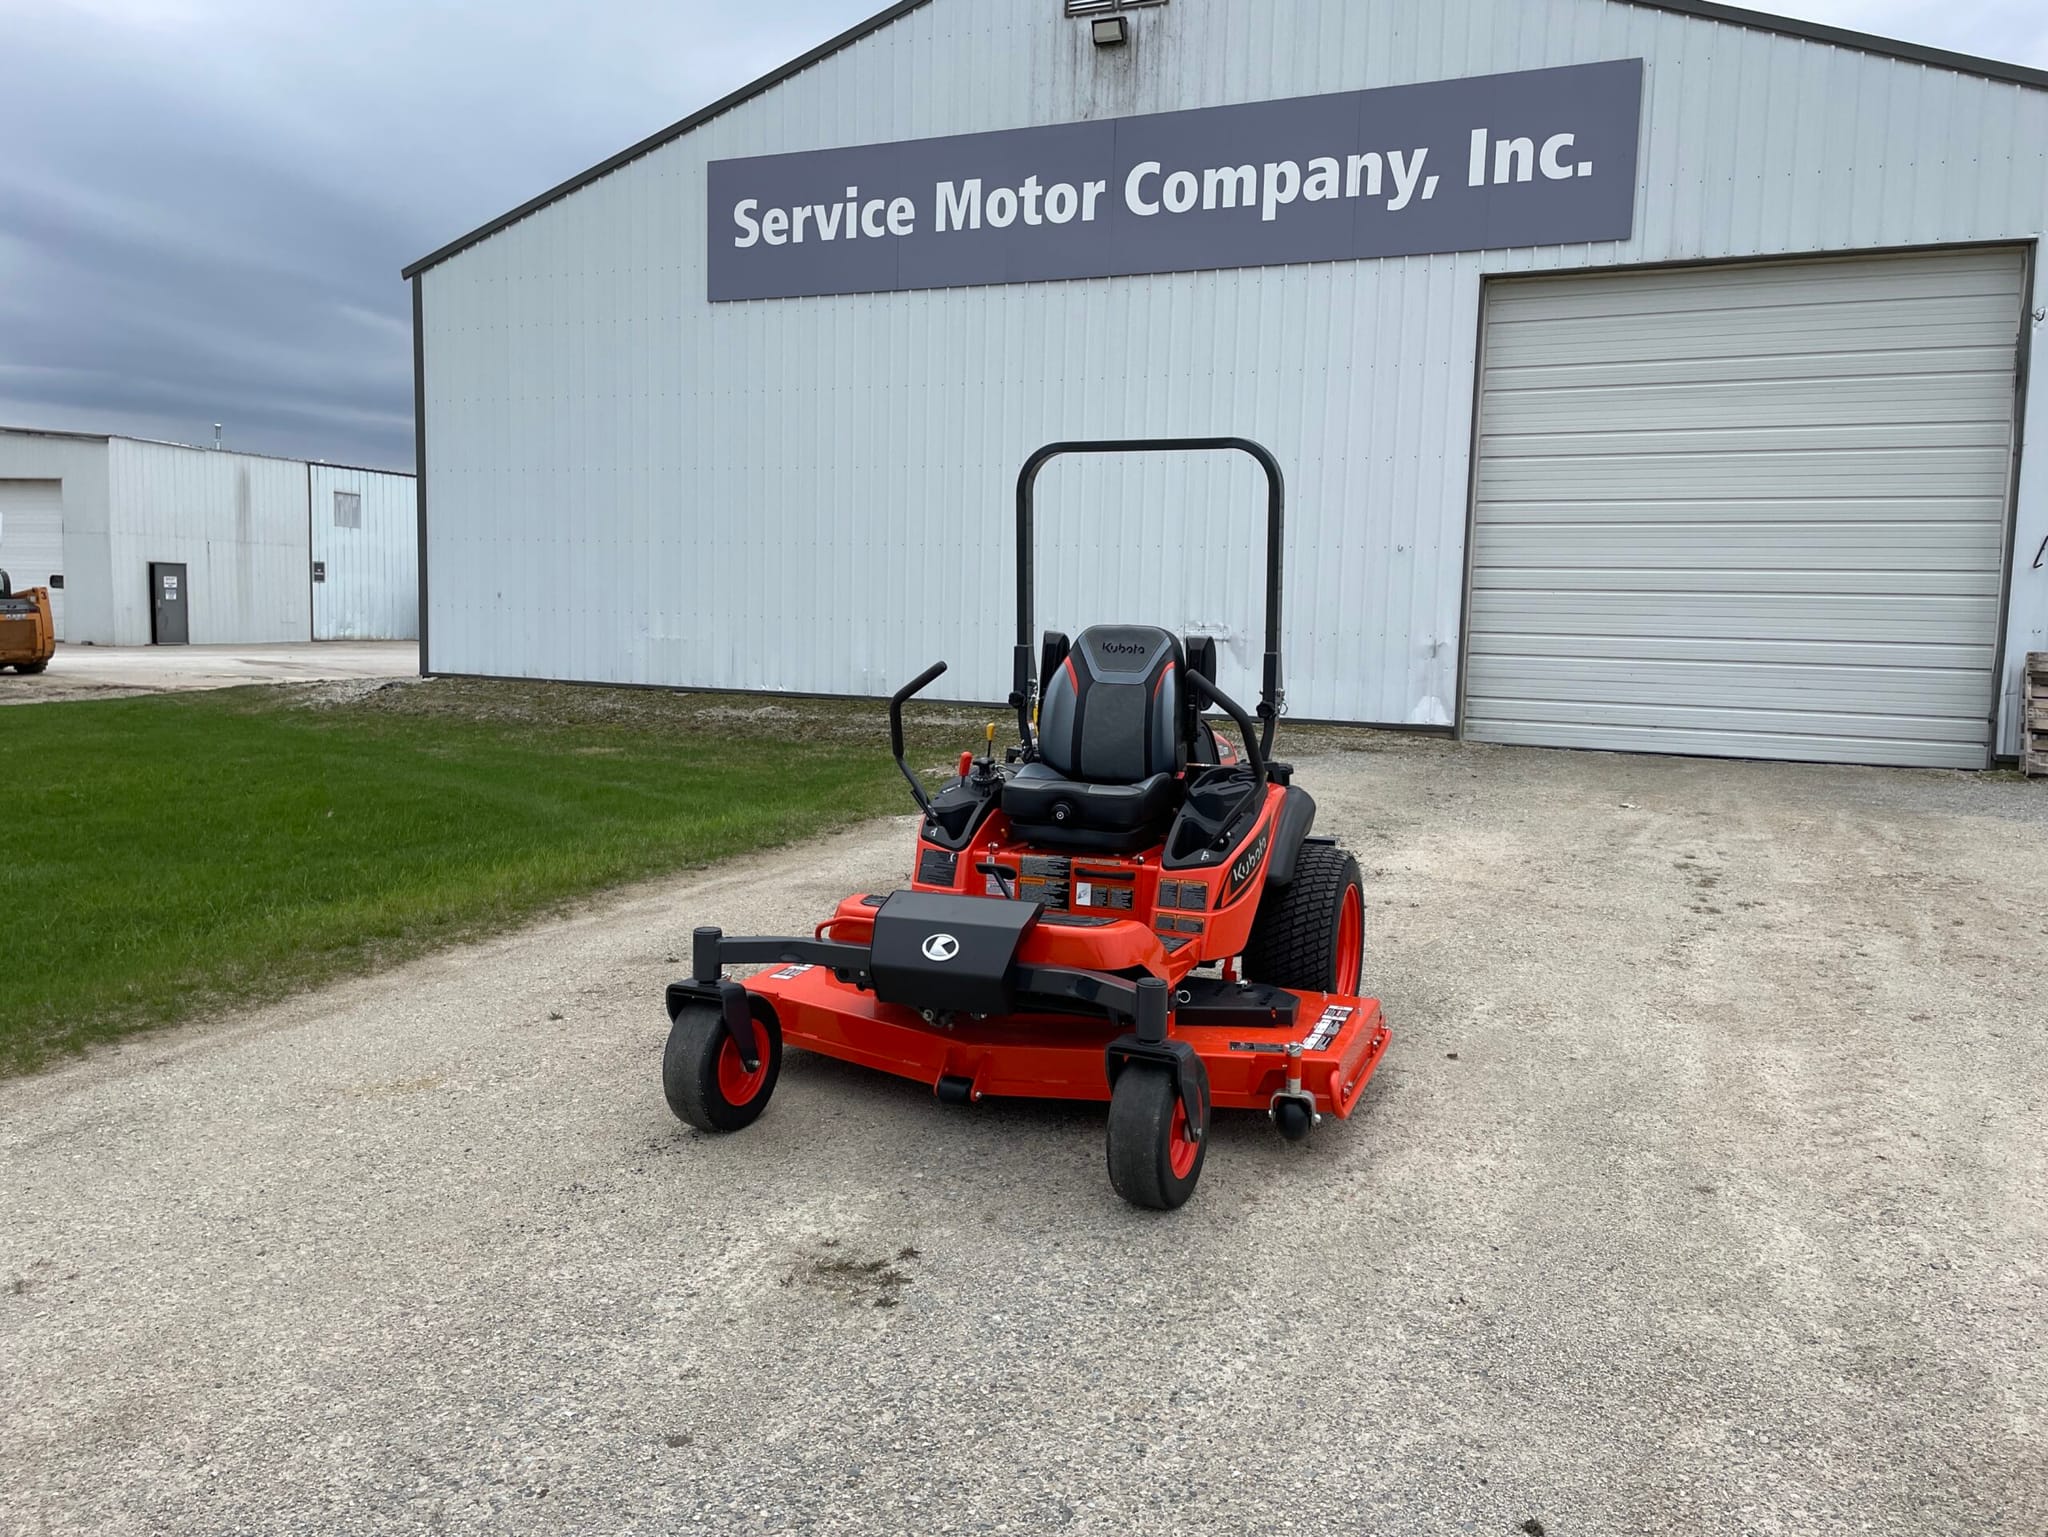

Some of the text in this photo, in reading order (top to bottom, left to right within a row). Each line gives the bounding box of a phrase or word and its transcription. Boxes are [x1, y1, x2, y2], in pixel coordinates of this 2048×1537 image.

[733, 128, 1593, 248] Service Motor Company, Inc.
[1102, 642, 1145, 655] Kubota
[1232, 837, 1267, 881] Kubota
